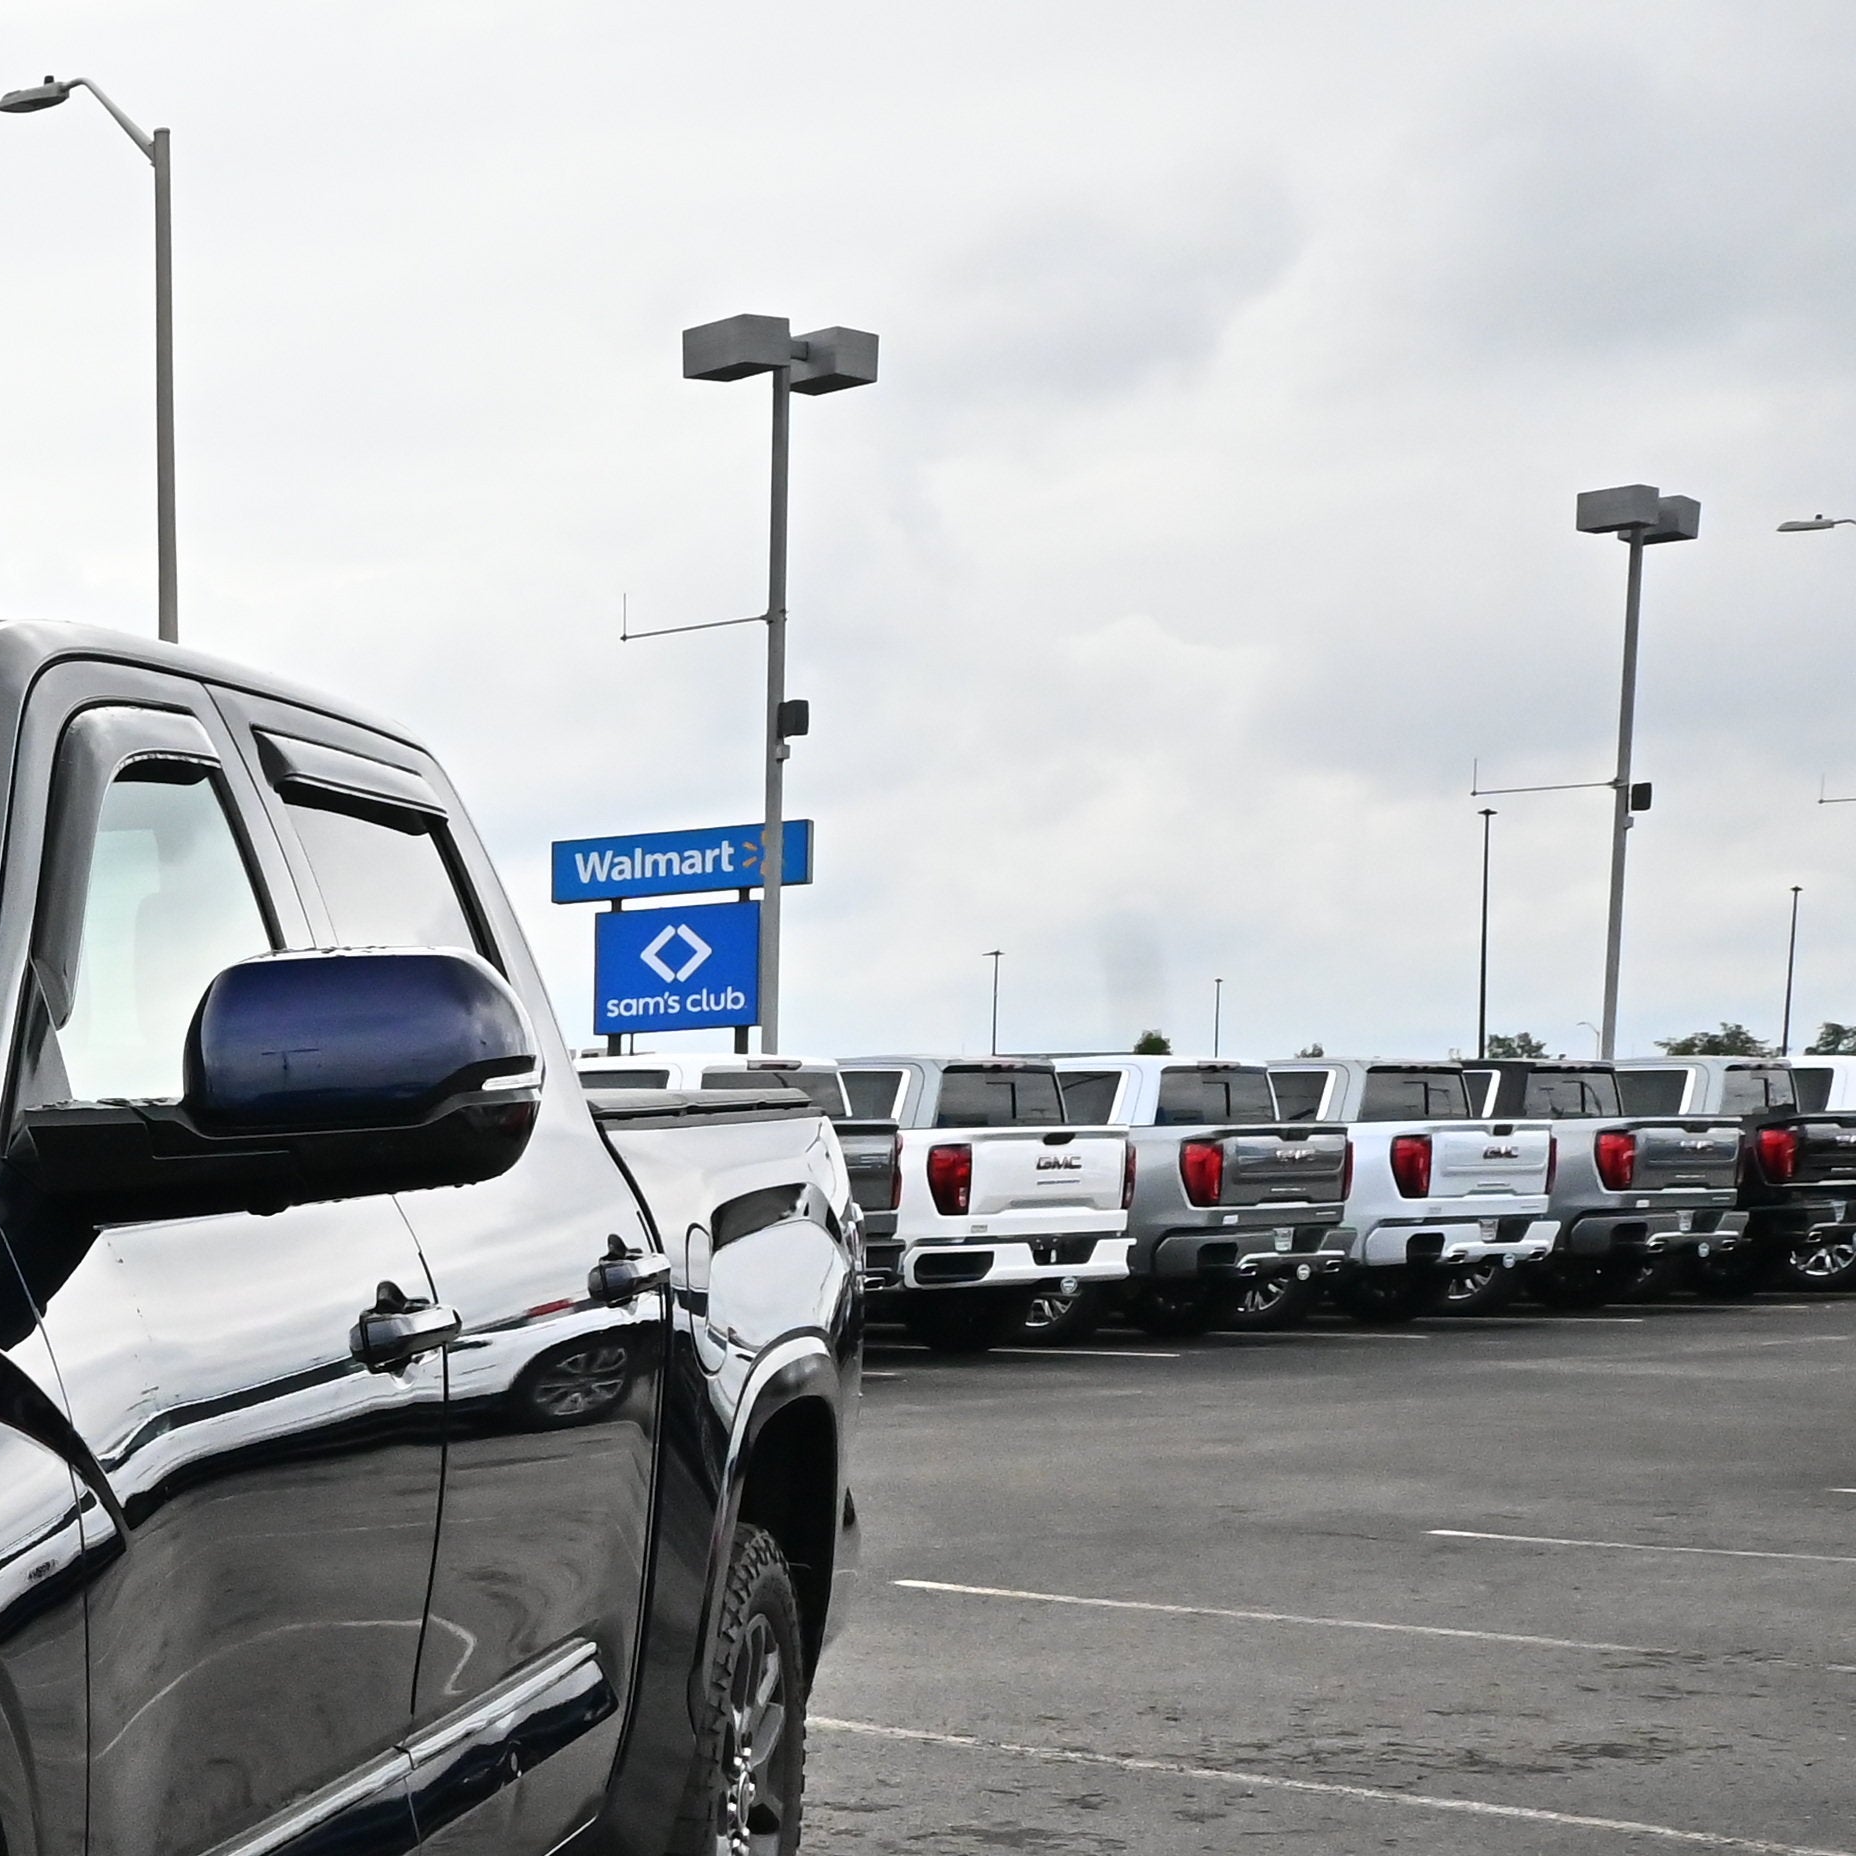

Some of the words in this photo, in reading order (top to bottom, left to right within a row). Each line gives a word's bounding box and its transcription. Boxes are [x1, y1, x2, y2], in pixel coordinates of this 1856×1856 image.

[574, 840, 735, 884] Walmart
[606, 991, 681, 1018] sam's
[686, 986, 747, 1013] club
[1035, 1156, 1082, 1170] GMC
